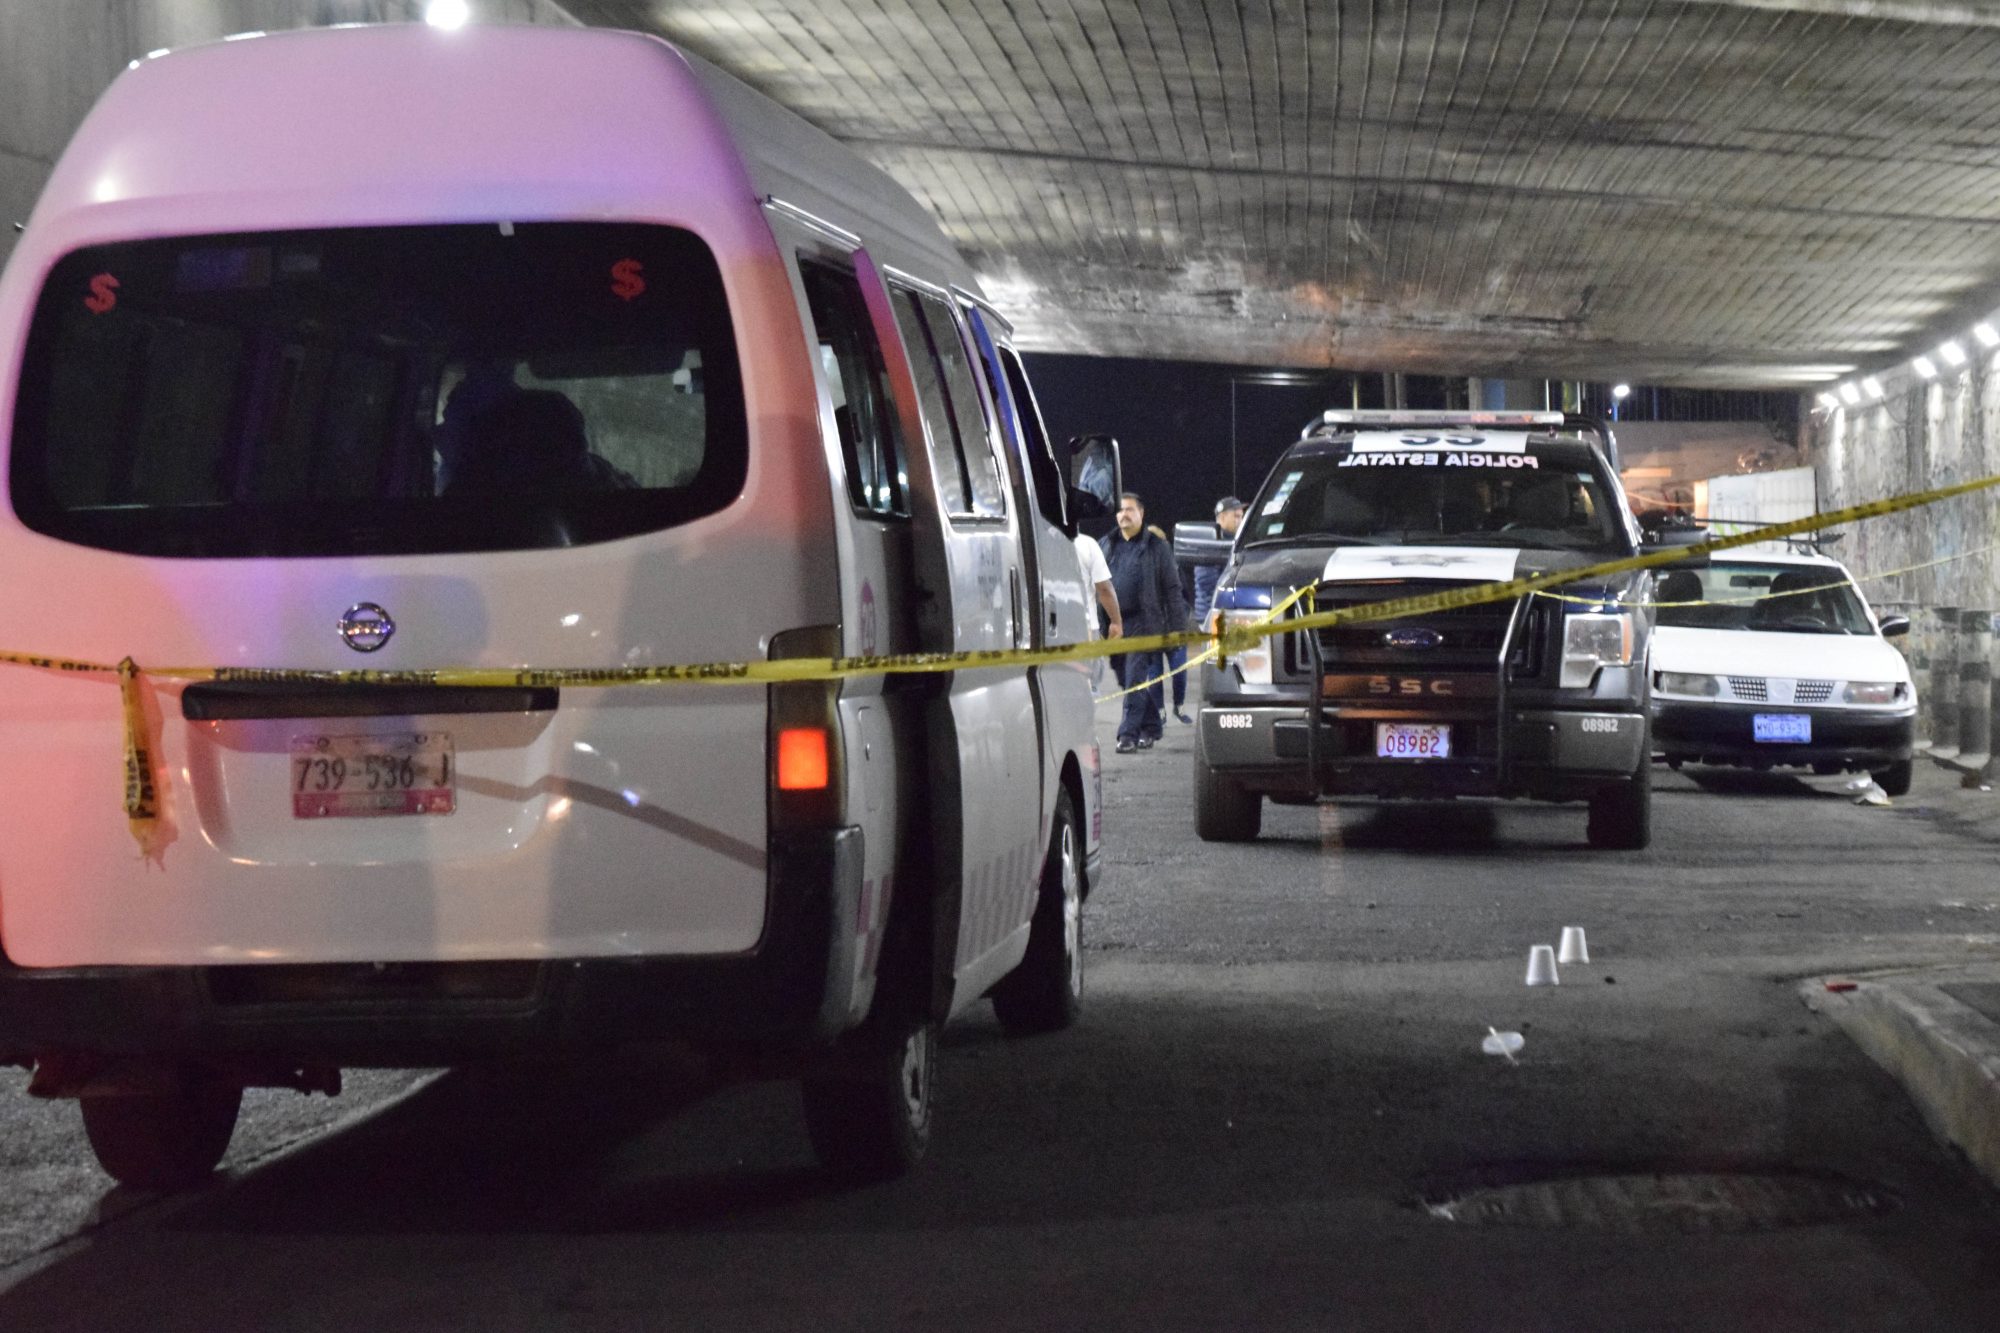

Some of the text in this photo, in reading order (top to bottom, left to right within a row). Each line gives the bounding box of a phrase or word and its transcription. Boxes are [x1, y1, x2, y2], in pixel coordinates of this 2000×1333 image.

[1367, 676, 1453, 695] SSC
[1219, 714, 1253, 729] 08982
[1582, 718, 1619, 732] 08982
[1385, 735, 1441, 754] 08982
